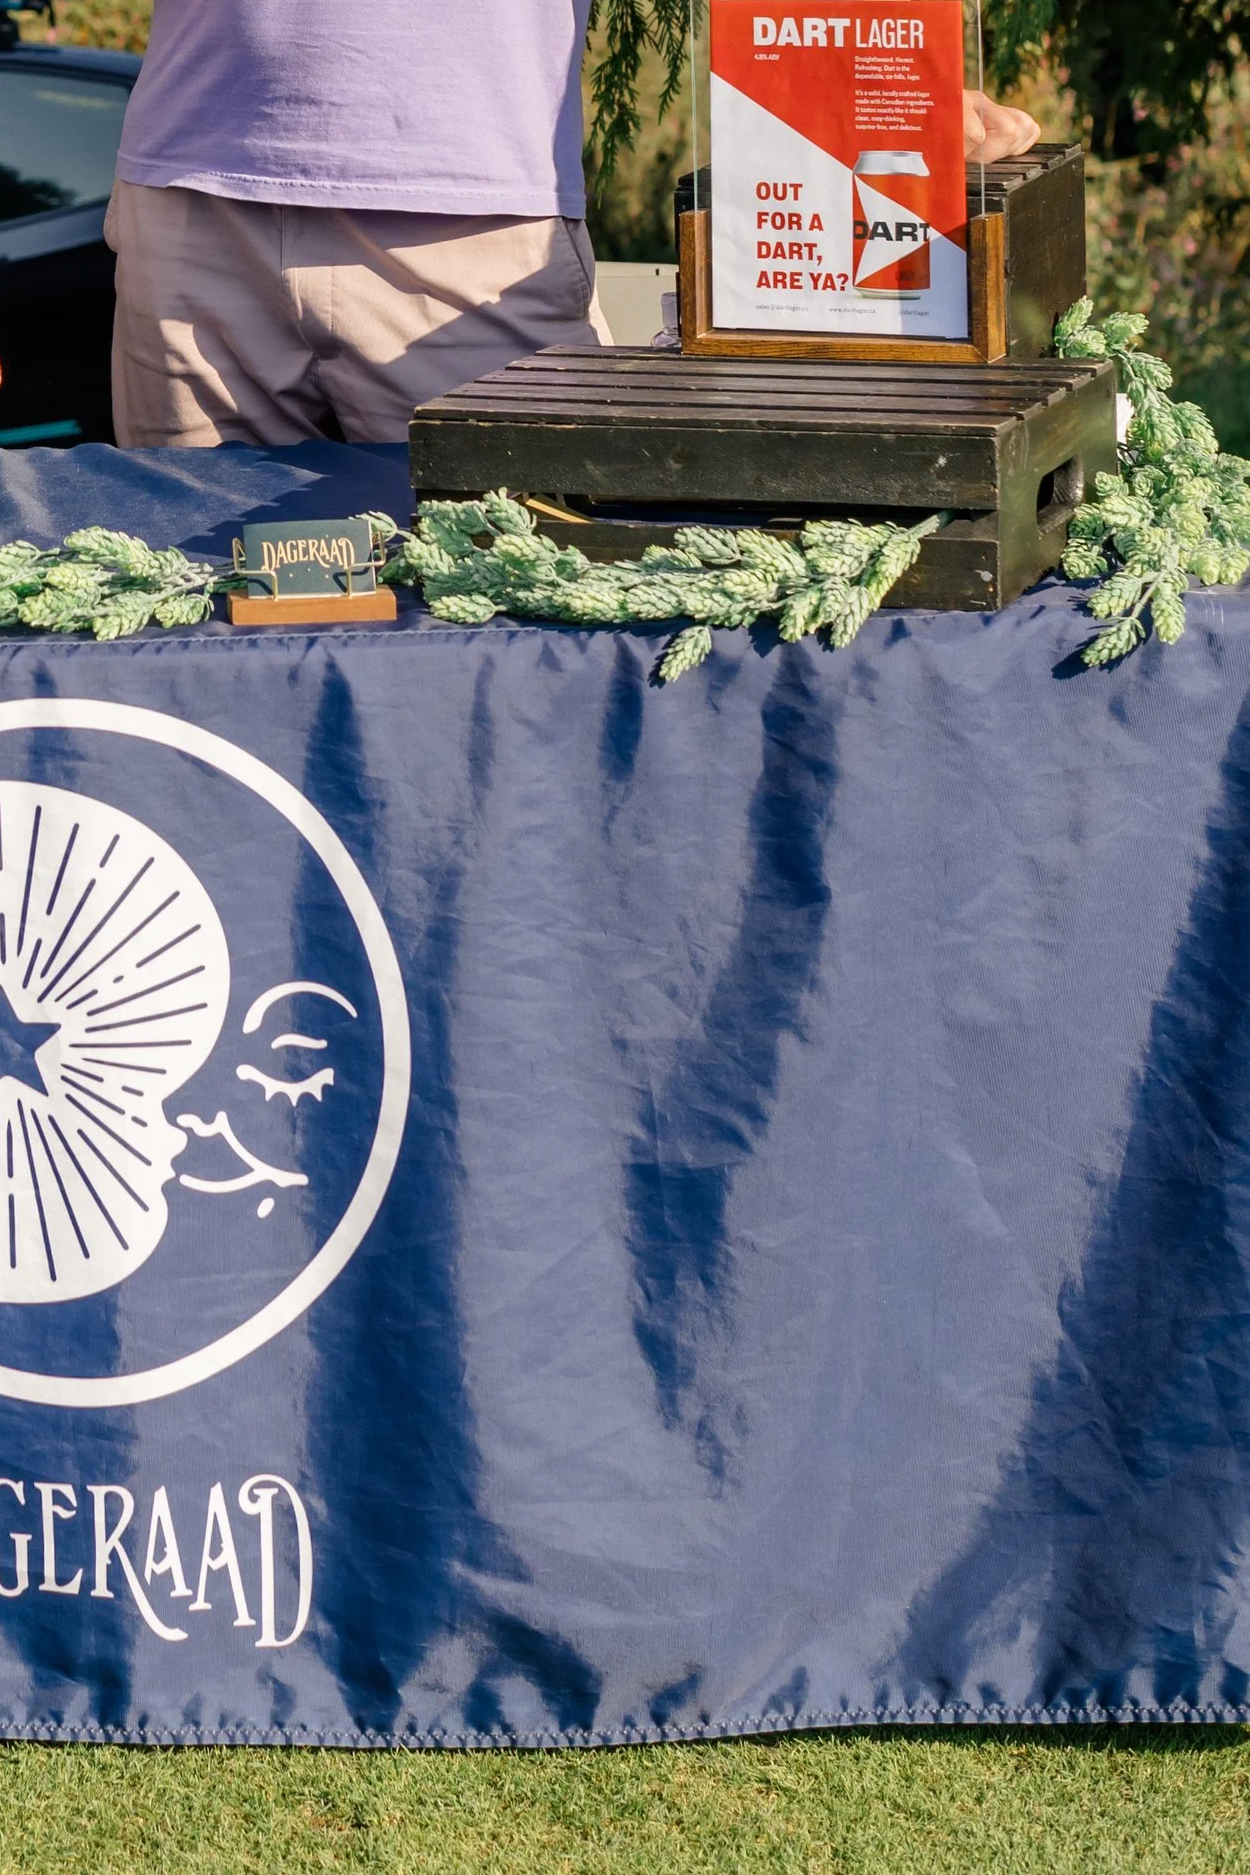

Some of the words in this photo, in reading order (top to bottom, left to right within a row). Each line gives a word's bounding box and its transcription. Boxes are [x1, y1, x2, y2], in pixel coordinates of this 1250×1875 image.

[753, 17, 851, 47] DART
[855, 18, 924, 49] LAGER
[756, 181, 803, 201] OUT
[757, 211, 802, 231] FOR
[809, 213, 824, 231] A
[853, 220, 930, 242] DART
[757, 241, 822, 266] DART,
[757, 271, 803, 289] ARE
[809, 272, 849, 291] YA?
[261, 537, 355, 571] DAGERAAD
